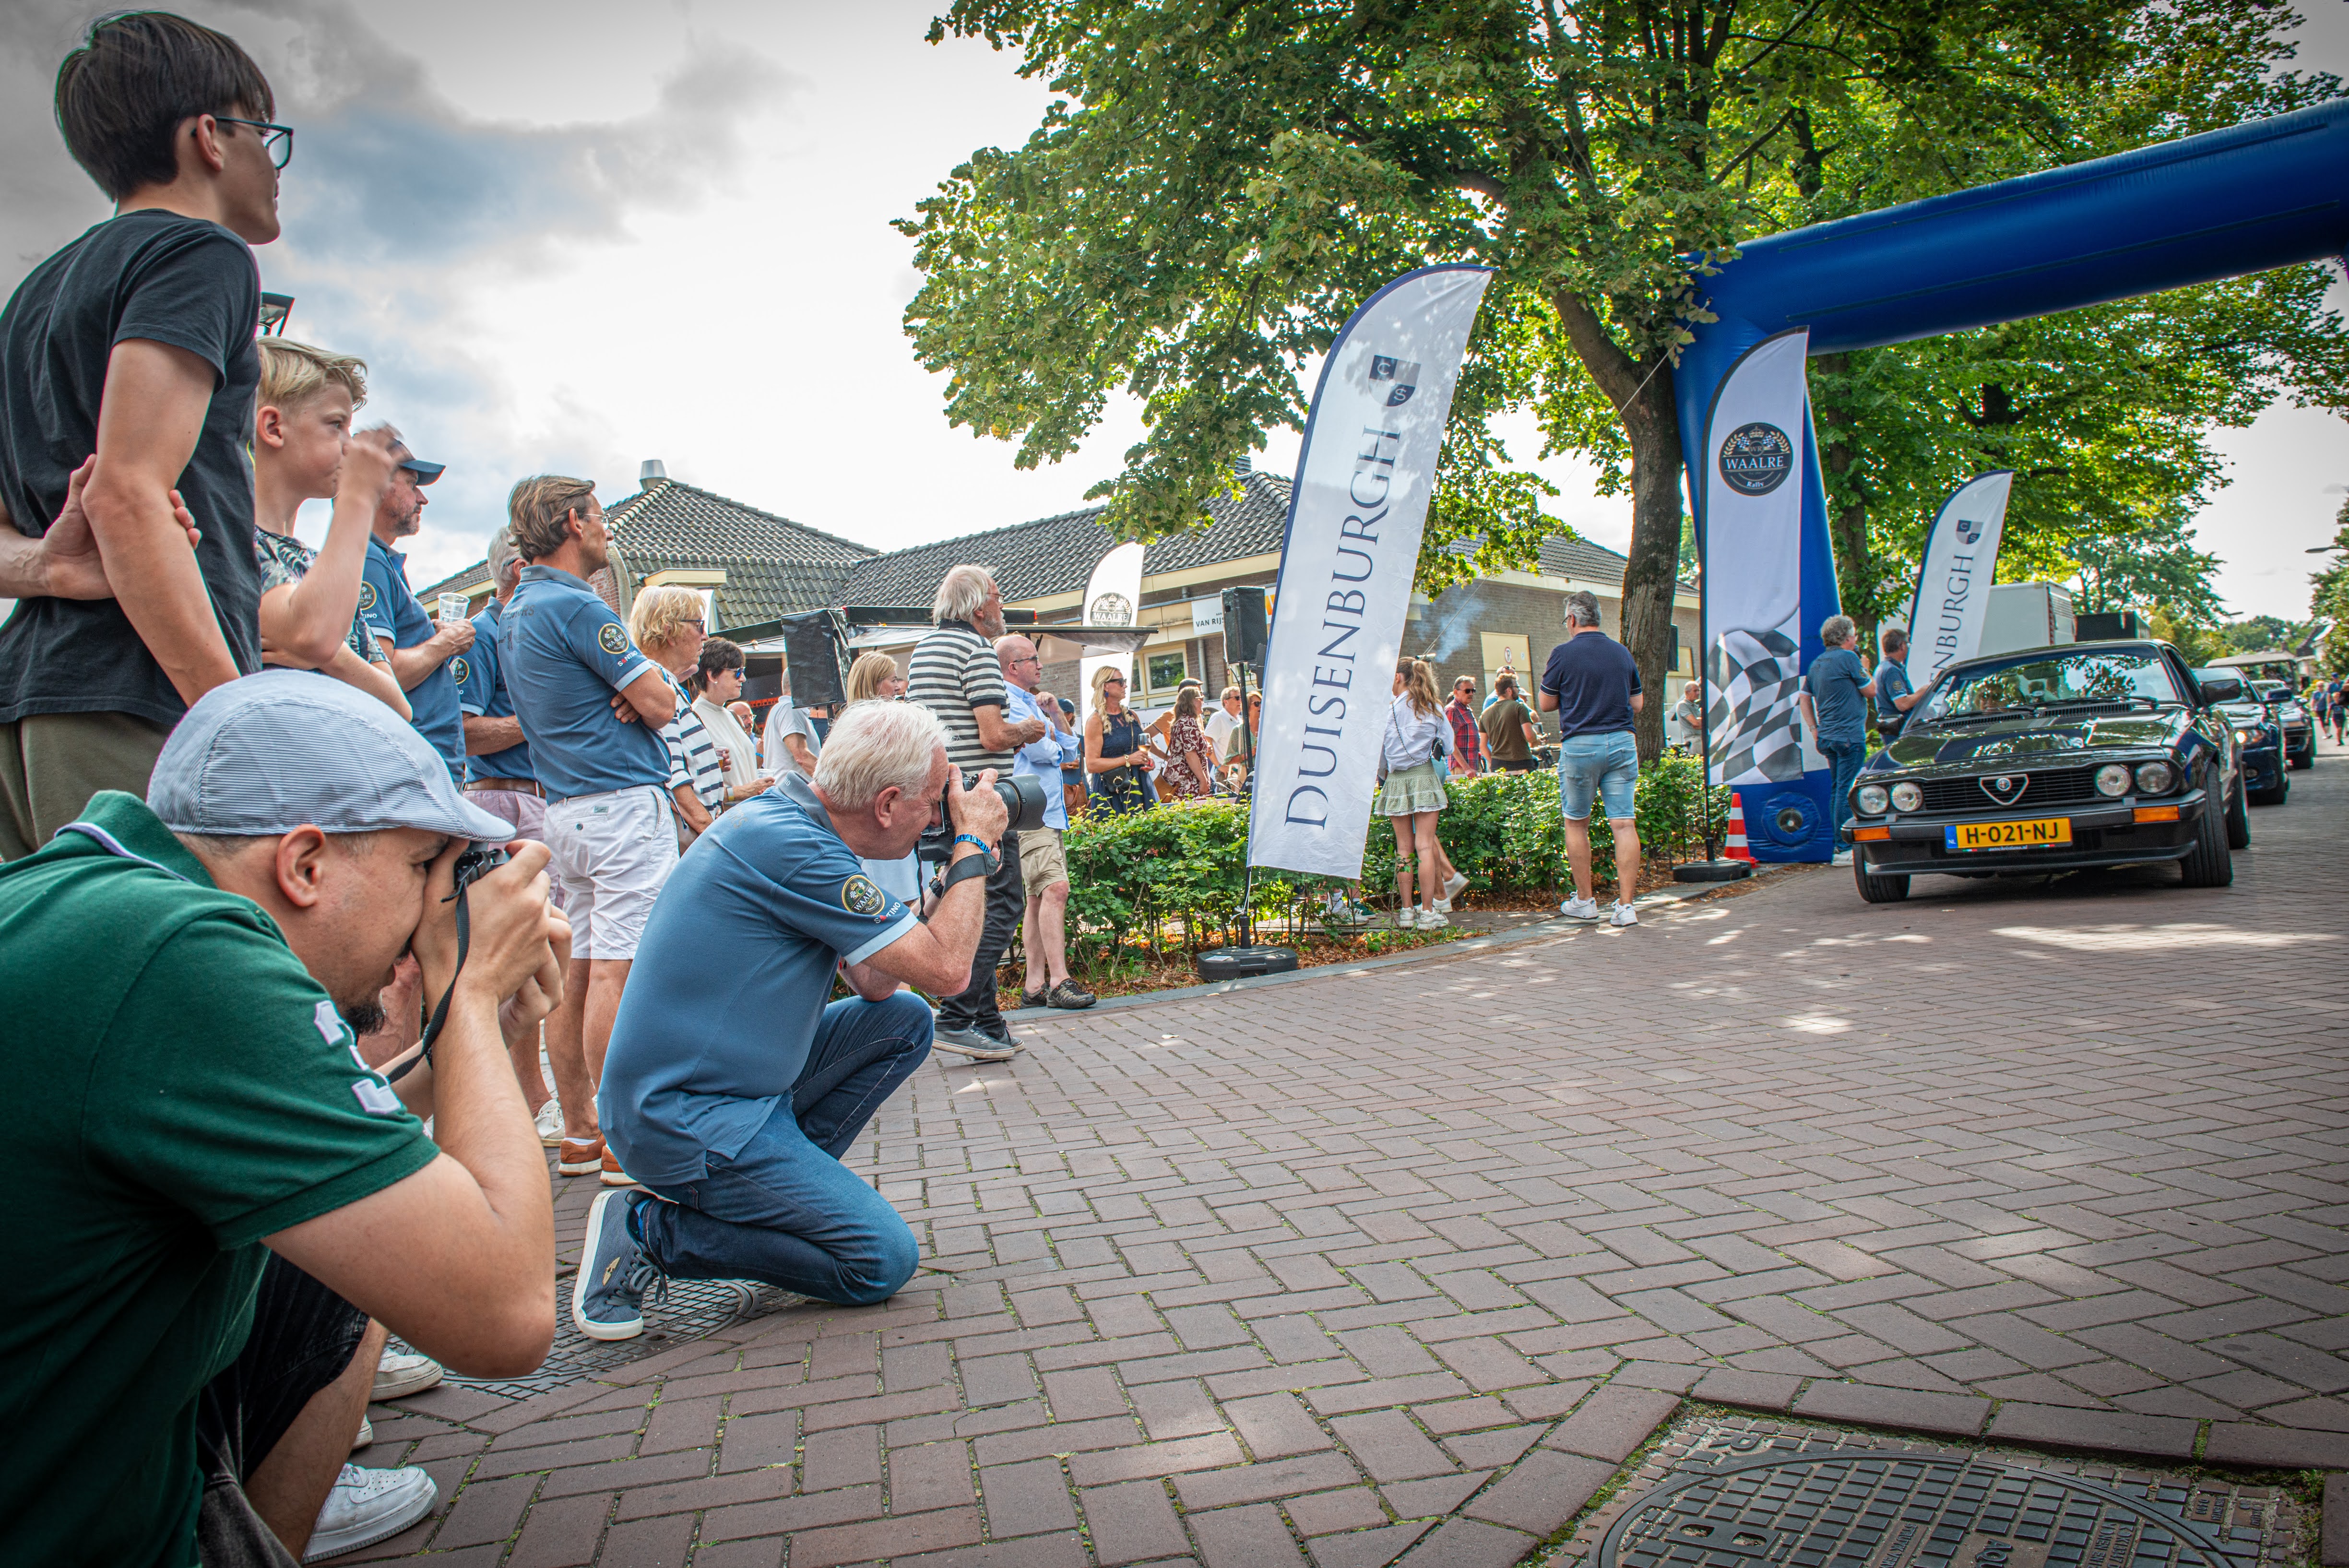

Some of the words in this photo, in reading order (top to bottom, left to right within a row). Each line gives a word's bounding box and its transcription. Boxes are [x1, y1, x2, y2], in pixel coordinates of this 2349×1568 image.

[1726, 456, 1784, 470] WAALRE
[1093, 612, 1128, 621] WAALRE
[1284, 425, 1401, 831] DUISENBURGH
[605, 633, 624, 648] WAALRE
[1966, 822, 2058, 844] H-021-NJ
[854, 886, 876, 911] WAALRE
